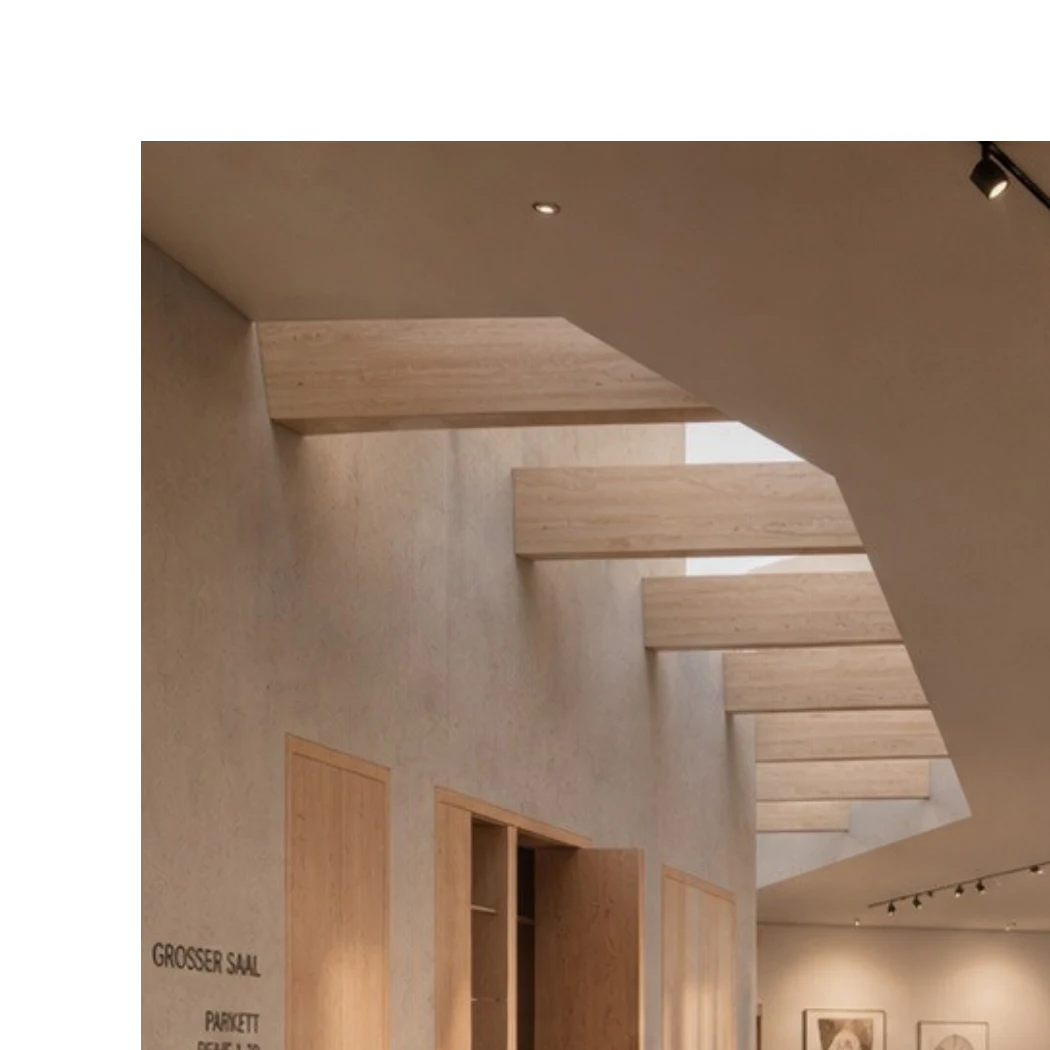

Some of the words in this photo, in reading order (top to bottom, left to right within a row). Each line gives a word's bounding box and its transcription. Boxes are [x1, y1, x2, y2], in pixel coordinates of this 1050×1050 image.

[152, 942, 222, 974] GROSSER
[226, 952, 261, 978] SAAL
[205, 1010, 260, 1034] PARKETT
